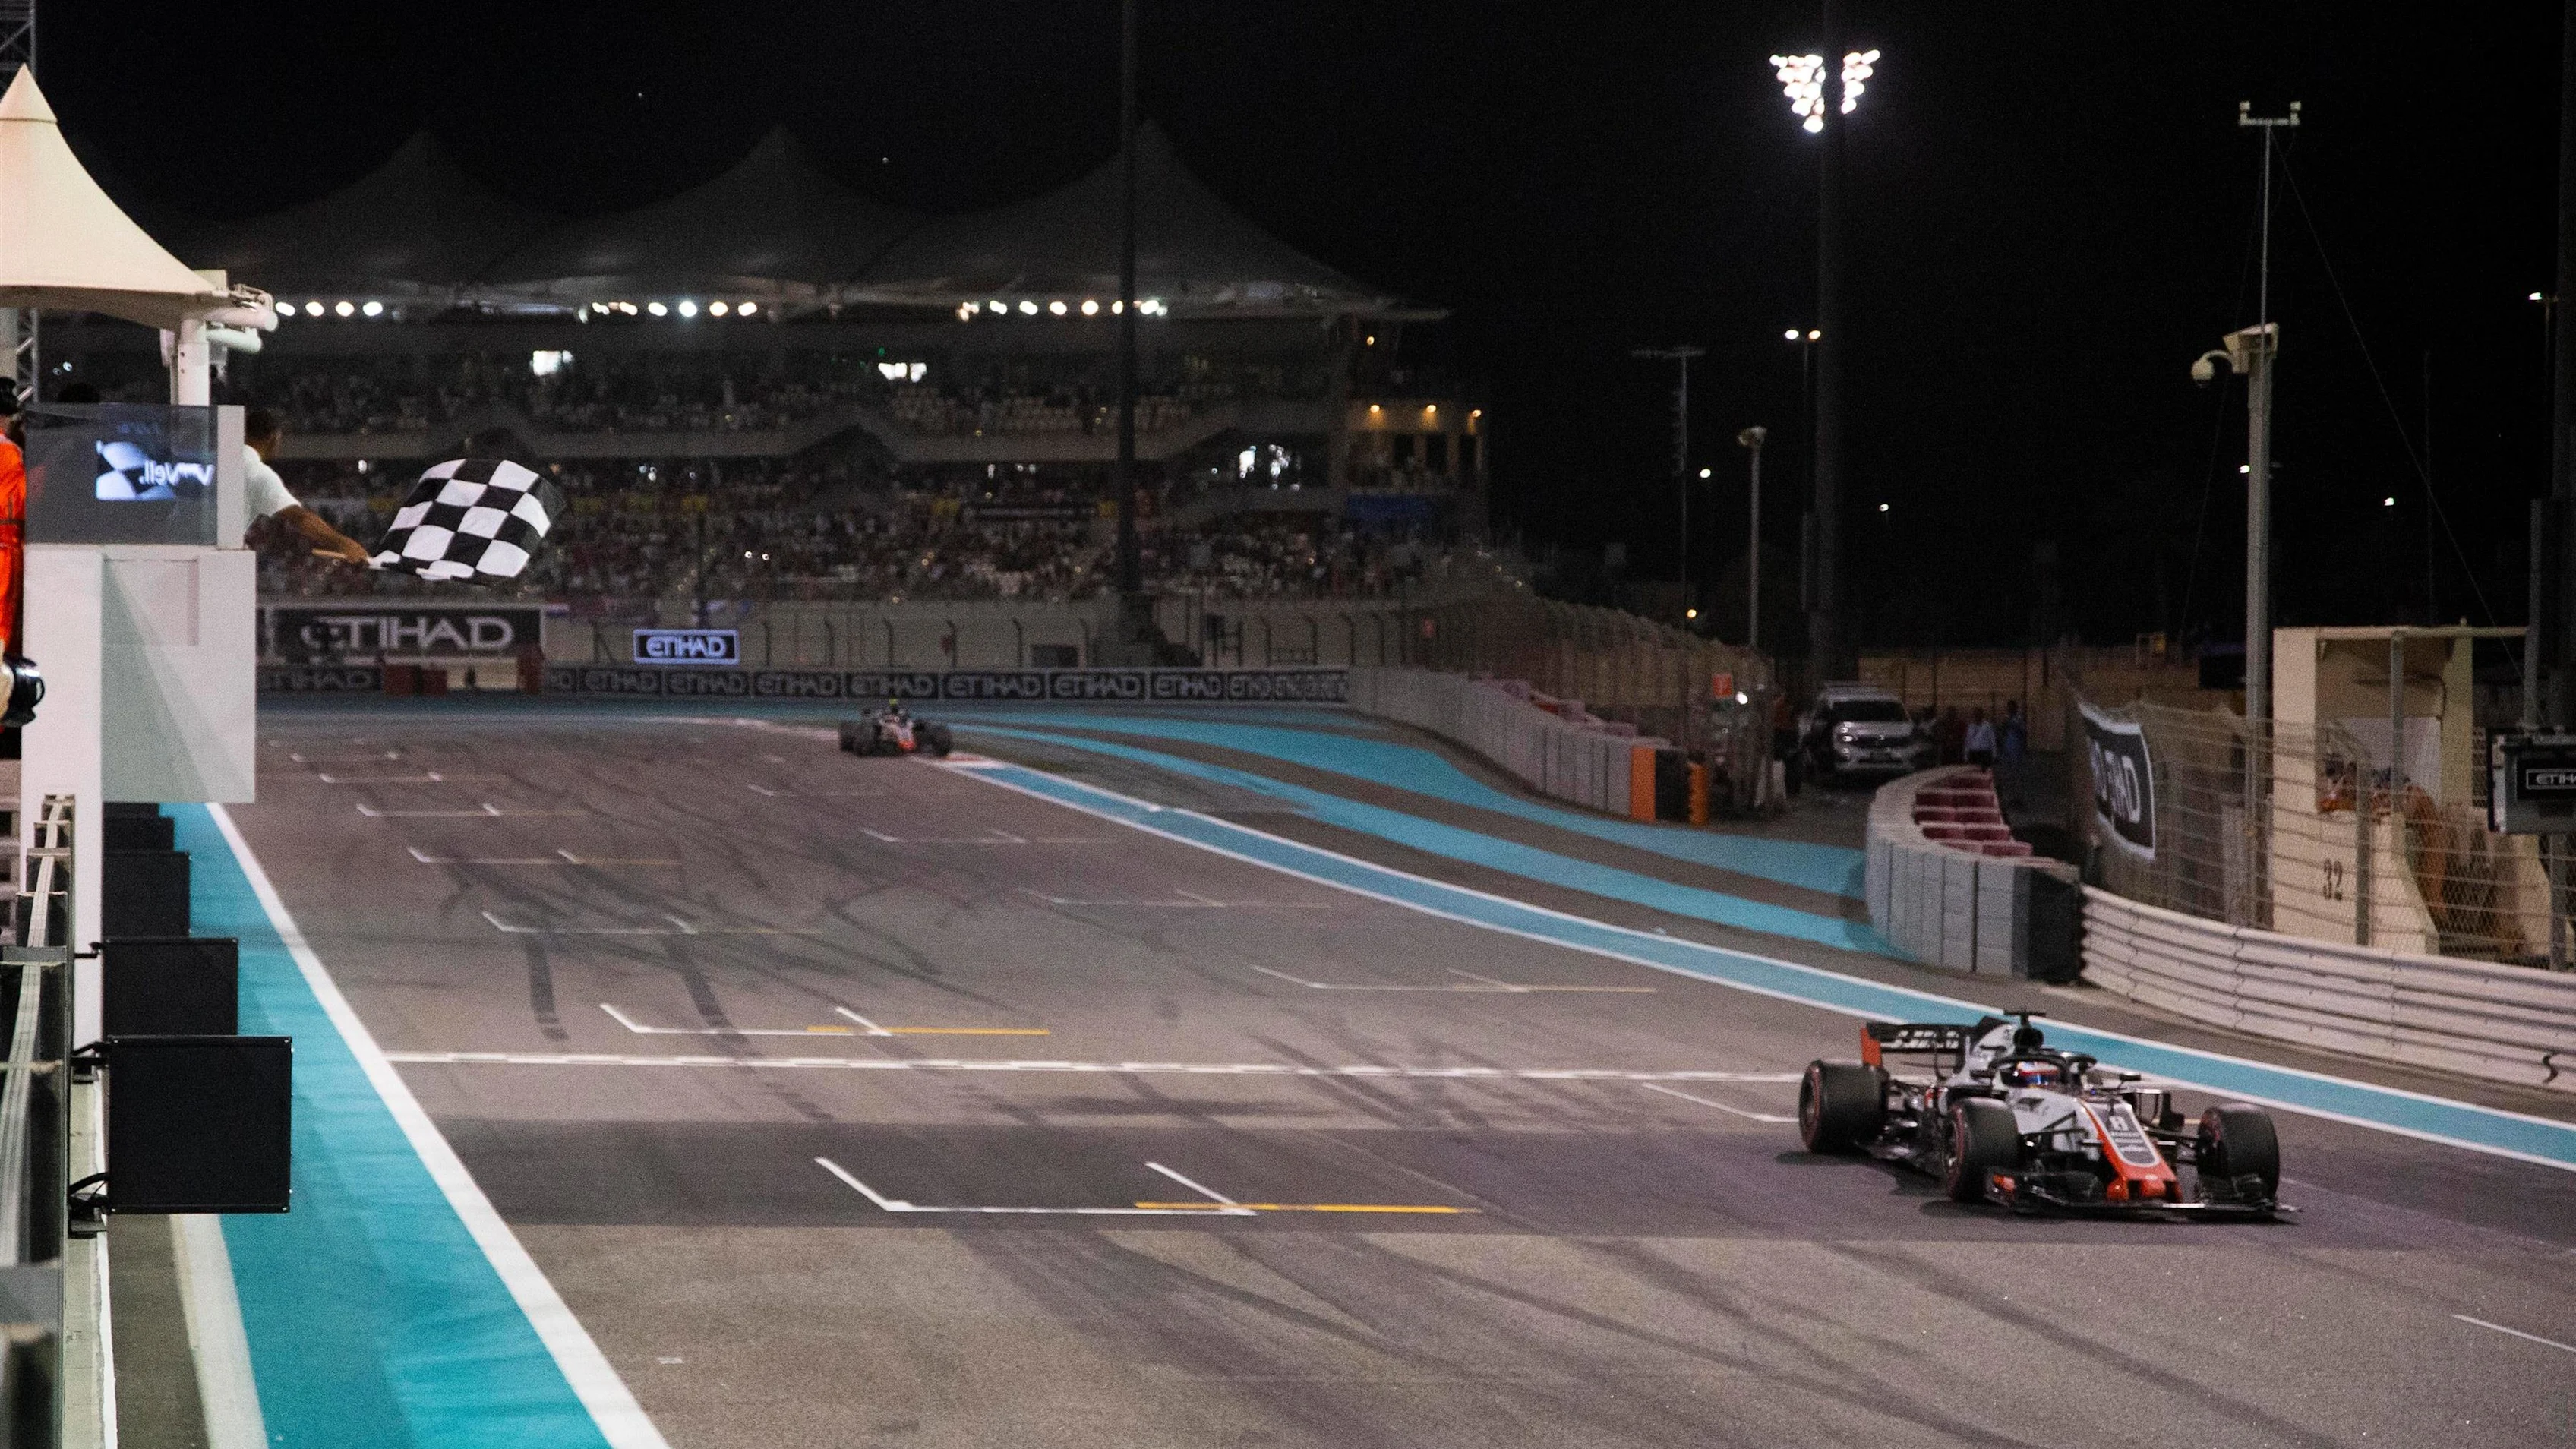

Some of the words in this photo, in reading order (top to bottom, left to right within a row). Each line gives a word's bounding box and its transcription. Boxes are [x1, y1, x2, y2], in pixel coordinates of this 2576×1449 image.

[646, 636, 727, 658] ETIHAD
[1054, 674, 1141, 697] ETIHAD
[2323, 858, 2343, 901] 32
